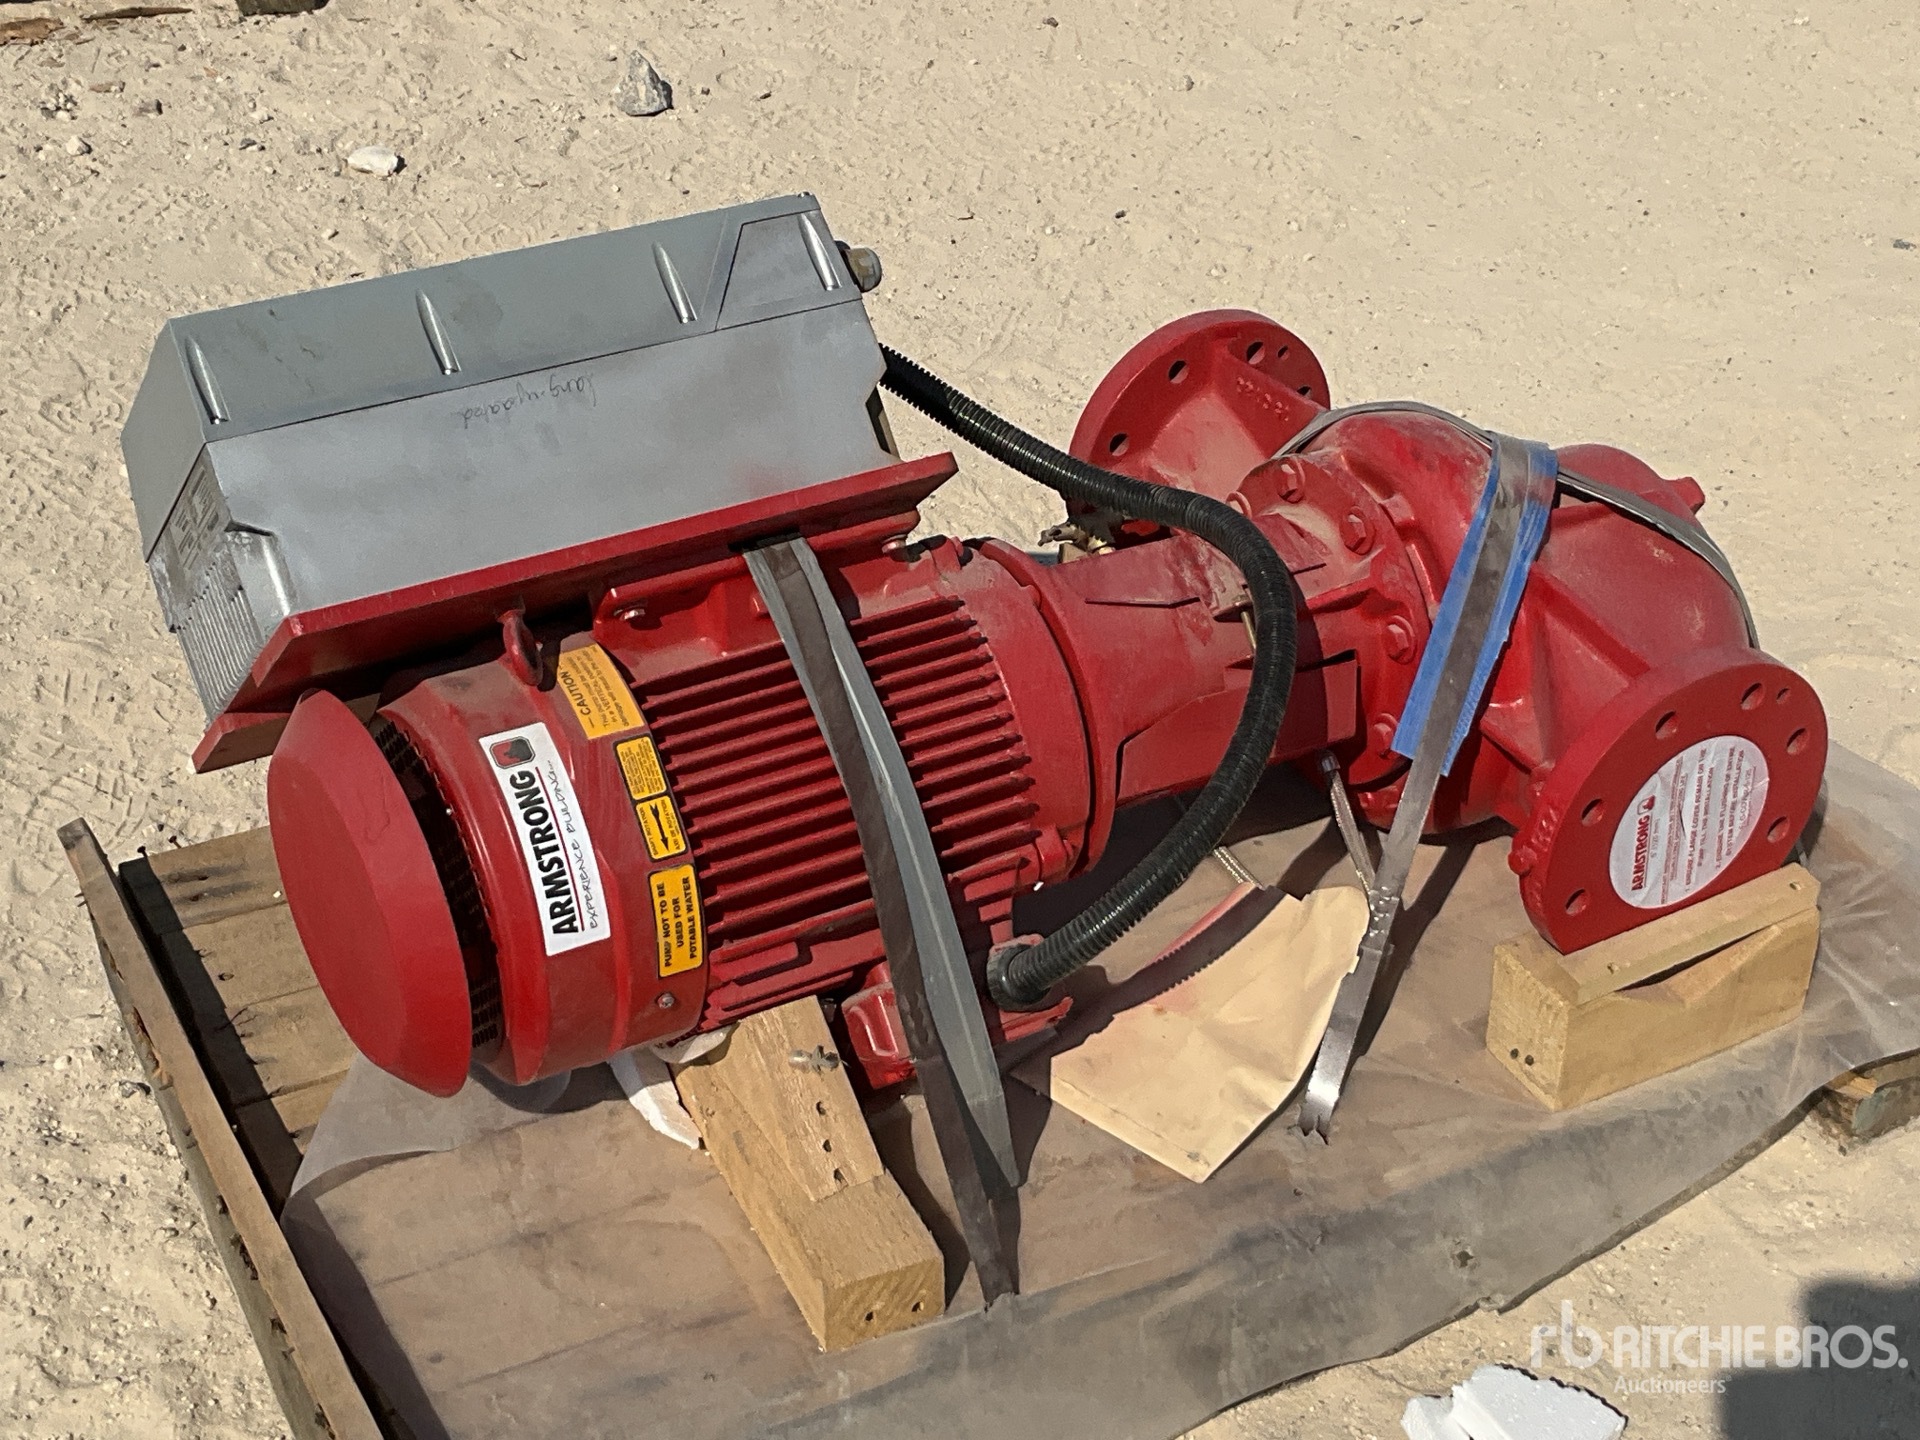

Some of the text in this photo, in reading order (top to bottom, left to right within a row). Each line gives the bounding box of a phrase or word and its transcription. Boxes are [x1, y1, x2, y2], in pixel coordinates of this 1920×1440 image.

[560, 671, 591, 715] CAUTION
[640, 807, 651, 837] ROTATION
[661, 800, 673, 829] ROTATION
[509, 770, 579, 934] ARMSTRONG
[1632, 815, 1649, 891] ARMSTRONG
[571, 839, 598, 929] EXPERIENCE
[658, 884, 665, 896] BE
[660, 900, 667, 913] TO
[684, 877, 697, 958] POTABLE WATER
[676, 921, 684, 947] USED
